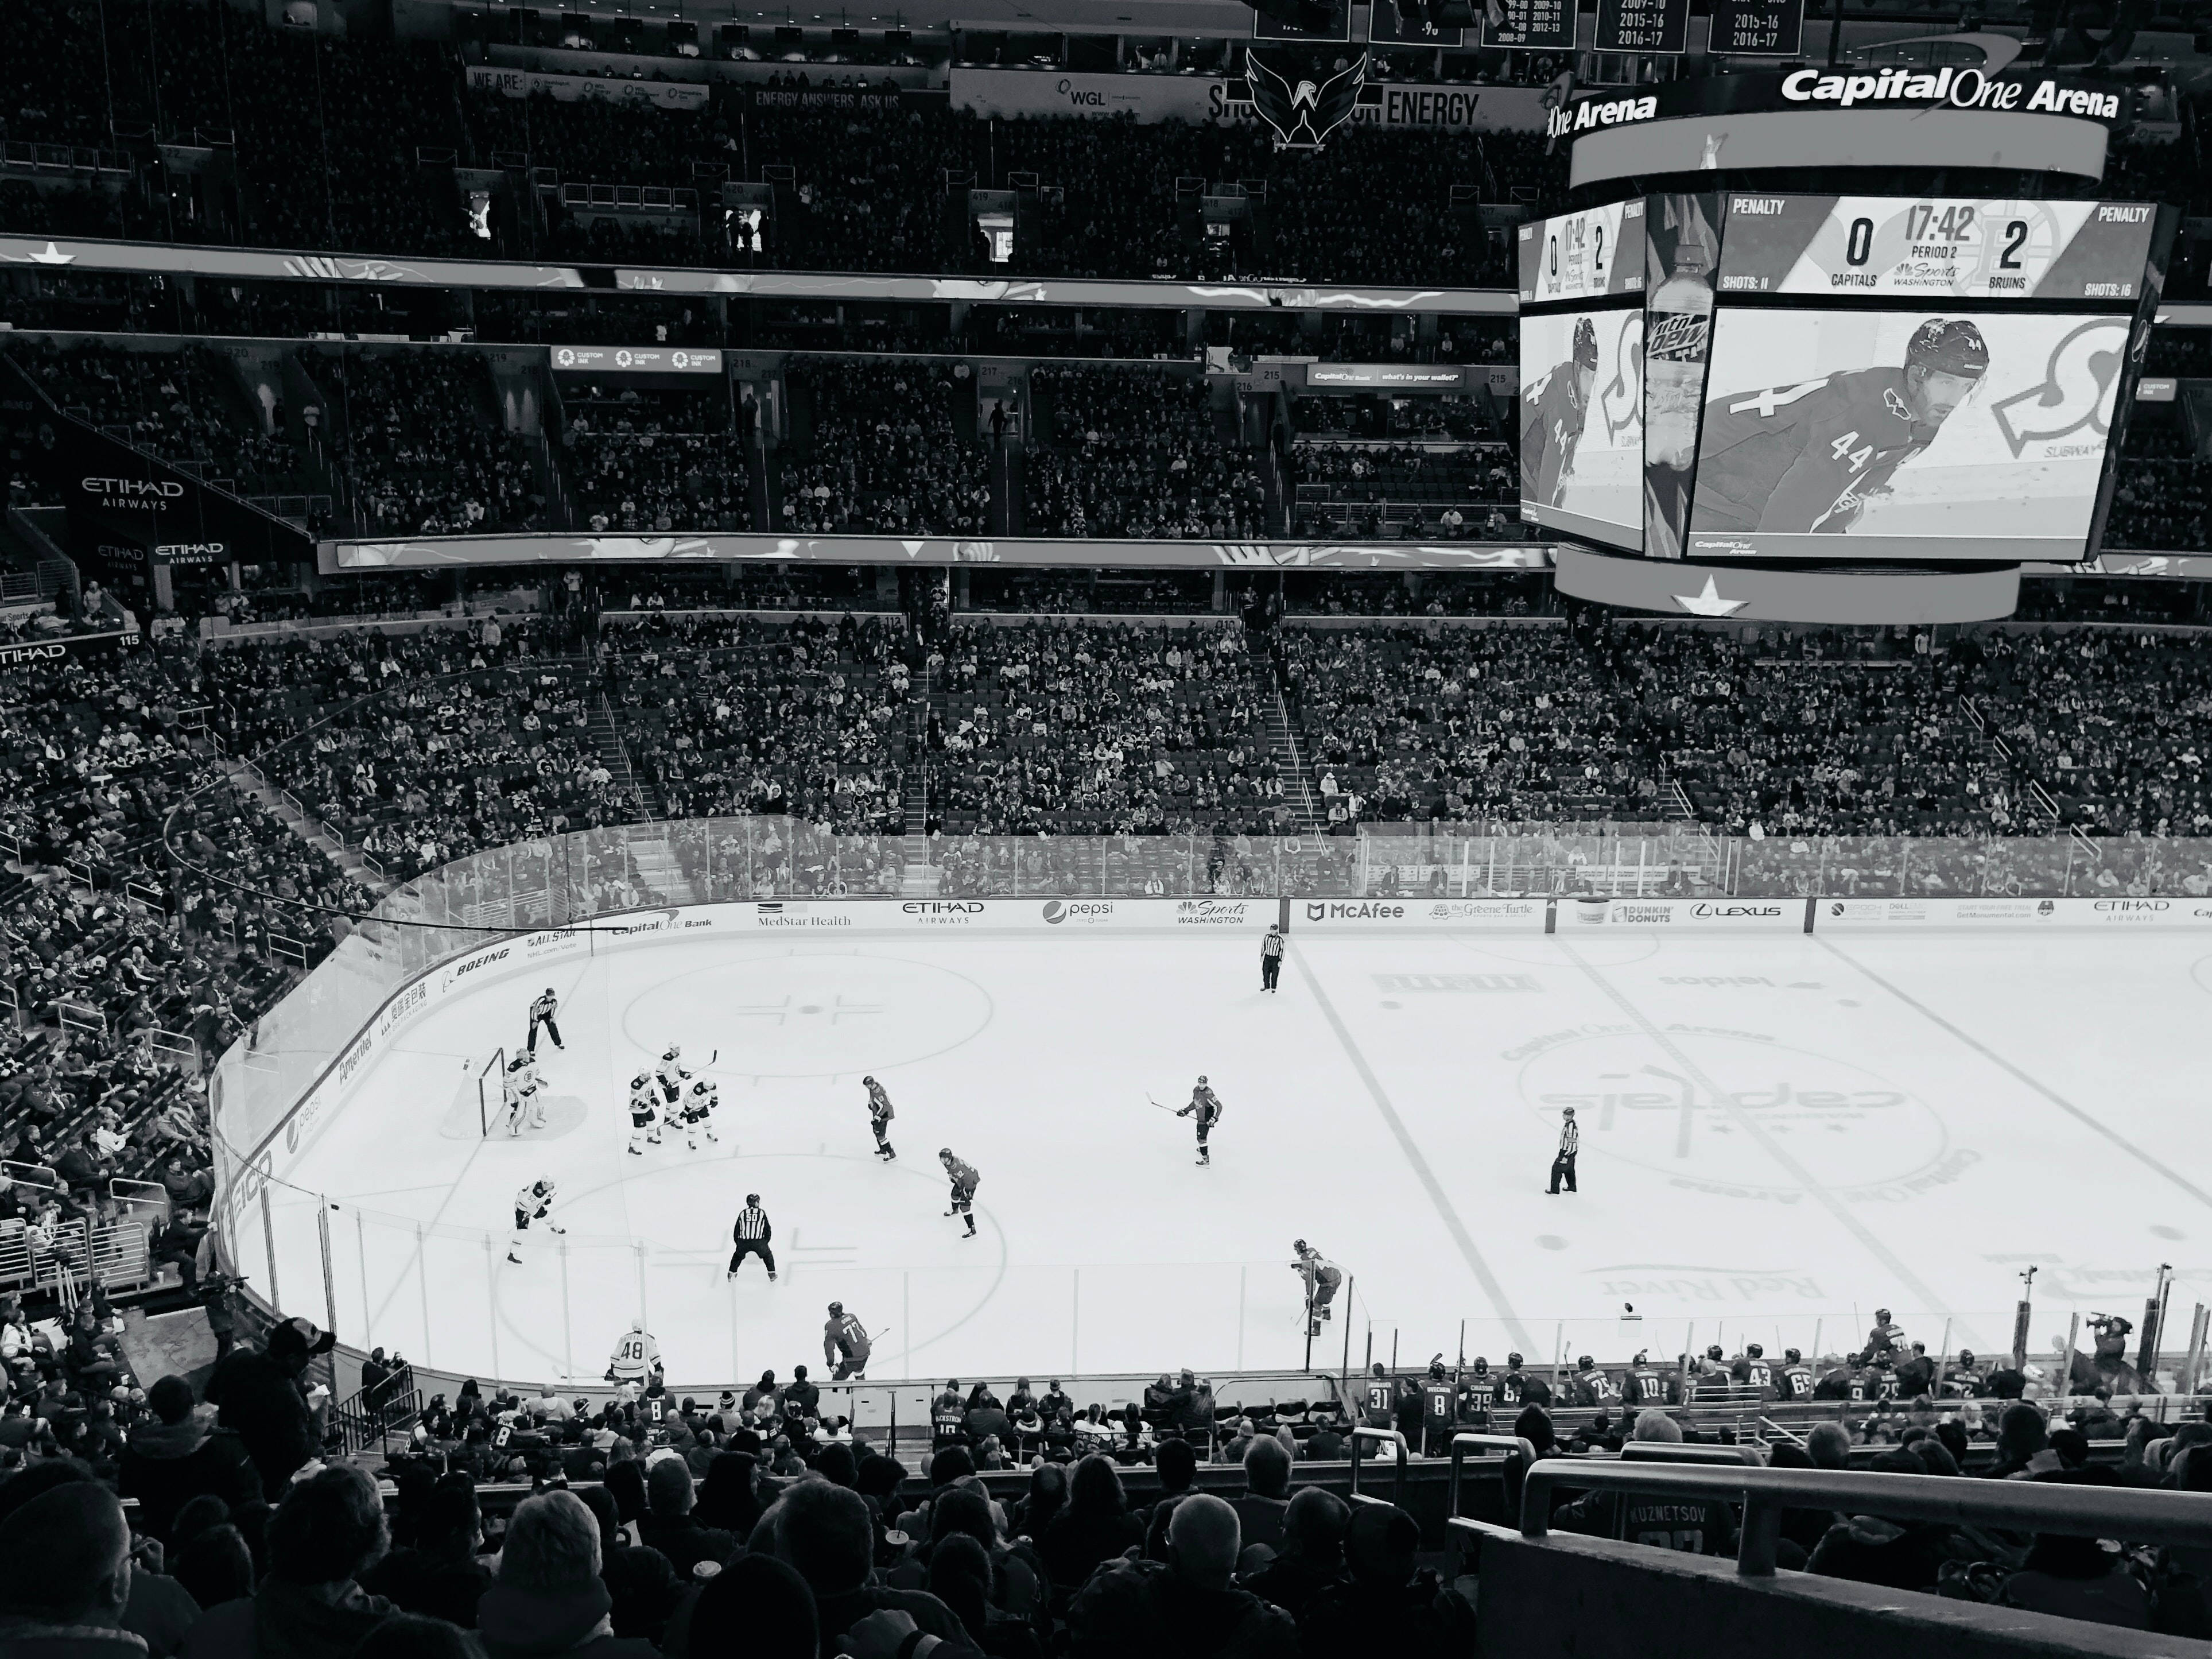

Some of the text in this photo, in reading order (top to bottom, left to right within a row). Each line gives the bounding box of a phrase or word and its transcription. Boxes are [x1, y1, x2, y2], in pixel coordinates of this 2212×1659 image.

[1533, 1, 1561, 10] 2009-10
[1533, 11, 1560, 20] 2010-11
[1620, 13, 1664, 28] 2015-16
[1734, 14, 1779, 29] 2015-16
[1532, 22, 1560, 32] 2012-13
[1498, 33, 1526, 42] 2008-09
[1618, 30, 1663, 45] 2016-17
[1732, 32, 1778, 46] 2016-17
[474, 72, 522, 90] WE ARE:
[756, 91, 799, 107] ENERGY
[860, 94, 882, 108] ASK
[884, 95, 899, 108] US
[1070, 91, 1105, 106] WGL
[2026, 80, 2119, 118] Arena
[1387, 91, 1479, 125] ENERGY
[1574, 96, 1658, 131] Arena
[725, 185, 743, 194] 420
[972, 193, 988, 201] 419
[1733, 199, 1785, 215] PENALTY
[2098, 206, 2149, 223] PENALTY
[1905, 206, 1974, 241] 17:42
[1566, 217, 1585, 251] 17:42
[1596, 226, 1602, 269] 2
[1846, 218, 1873, 266] 0
[2000, 221, 2028, 269] 2
[1551, 235, 1557, 276] 0
[1912, 246, 1957, 258] PERIOD 2
[1913, 263, 1960, 278] Sports
[1723, 276, 1759, 289] SHOTS:
[1831, 274, 1877, 287] CAPITALS
[1989, 277, 2025, 289] BRUINS
[488, 352, 506, 362] 219
[733, 359, 751, 368] 218
[981, 367, 997, 376] 217
[1264, 371, 1279, 380] 215
[1382, 373, 1404, 381] what's
[1415, 374, 1429, 382] your
[1490, 374, 1505, 383] 215
[1007, 376, 1023, 385] 216
[1237, 382, 1252, 391] 216
[1554, 418, 1568, 456] 44
[1831, 431, 1873, 474] 44
[82, 477, 184, 497] ETIHAD
[102, 498, 167, 511] AIRWAYS
[98, 545, 144, 561] ETIHAD
[155, 542, 224, 555] ETIHAD
[169, 555, 214, 564] AIRWAYS
[120, 635, 139, 647] 115
[902, 902, 985, 914] ETIHAD
[1070, 901, 1113, 917] pepsi
[1198, 901, 1249, 916] Sports
[1331, 902, 1405, 918] McAfee
[1464, 903, 1502, 917] Greene
[1502, 904, 1534, 914] Turtle
[1628, 906, 1674, 914] DUNKIN'
[1716, 907, 1781, 916] LEXUS
[2094, 901, 2170, 912] ETIHAD
[685, 918, 712, 928] Bank
[758, 916, 852, 927] MedStar Health
[1628, 914, 1671, 922] DONUTS
[2106, 914, 2154, 922] AIRWAYS
[457, 948, 510, 976] BOEING
[1658, 976, 1777, 988] leidos
[1665, 1022, 1776, 1042] Arena
[300, 1090, 321, 1133] pepsi
[1669, 1179, 1803, 1206] Arena
[1600, 1277, 1829, 1304] Red River
[842, 1321, 866, 1344] 77
[620, 1342, 643, 1360] 48
[1749, 1367, 1771, 1386] 43
[1640, 1378, 1659, 1398] 10
[1371, 1389, 1388, 1410] 31
[1434, 1394, 1445, 1416] 8
[1470, 1393, 1493, 1412] 39
[651, 1401, 662, 1421] 8
[496, 1425, 511, 1447] 8
[1630, 1505, 1706, 1524] KUZNETSOV
